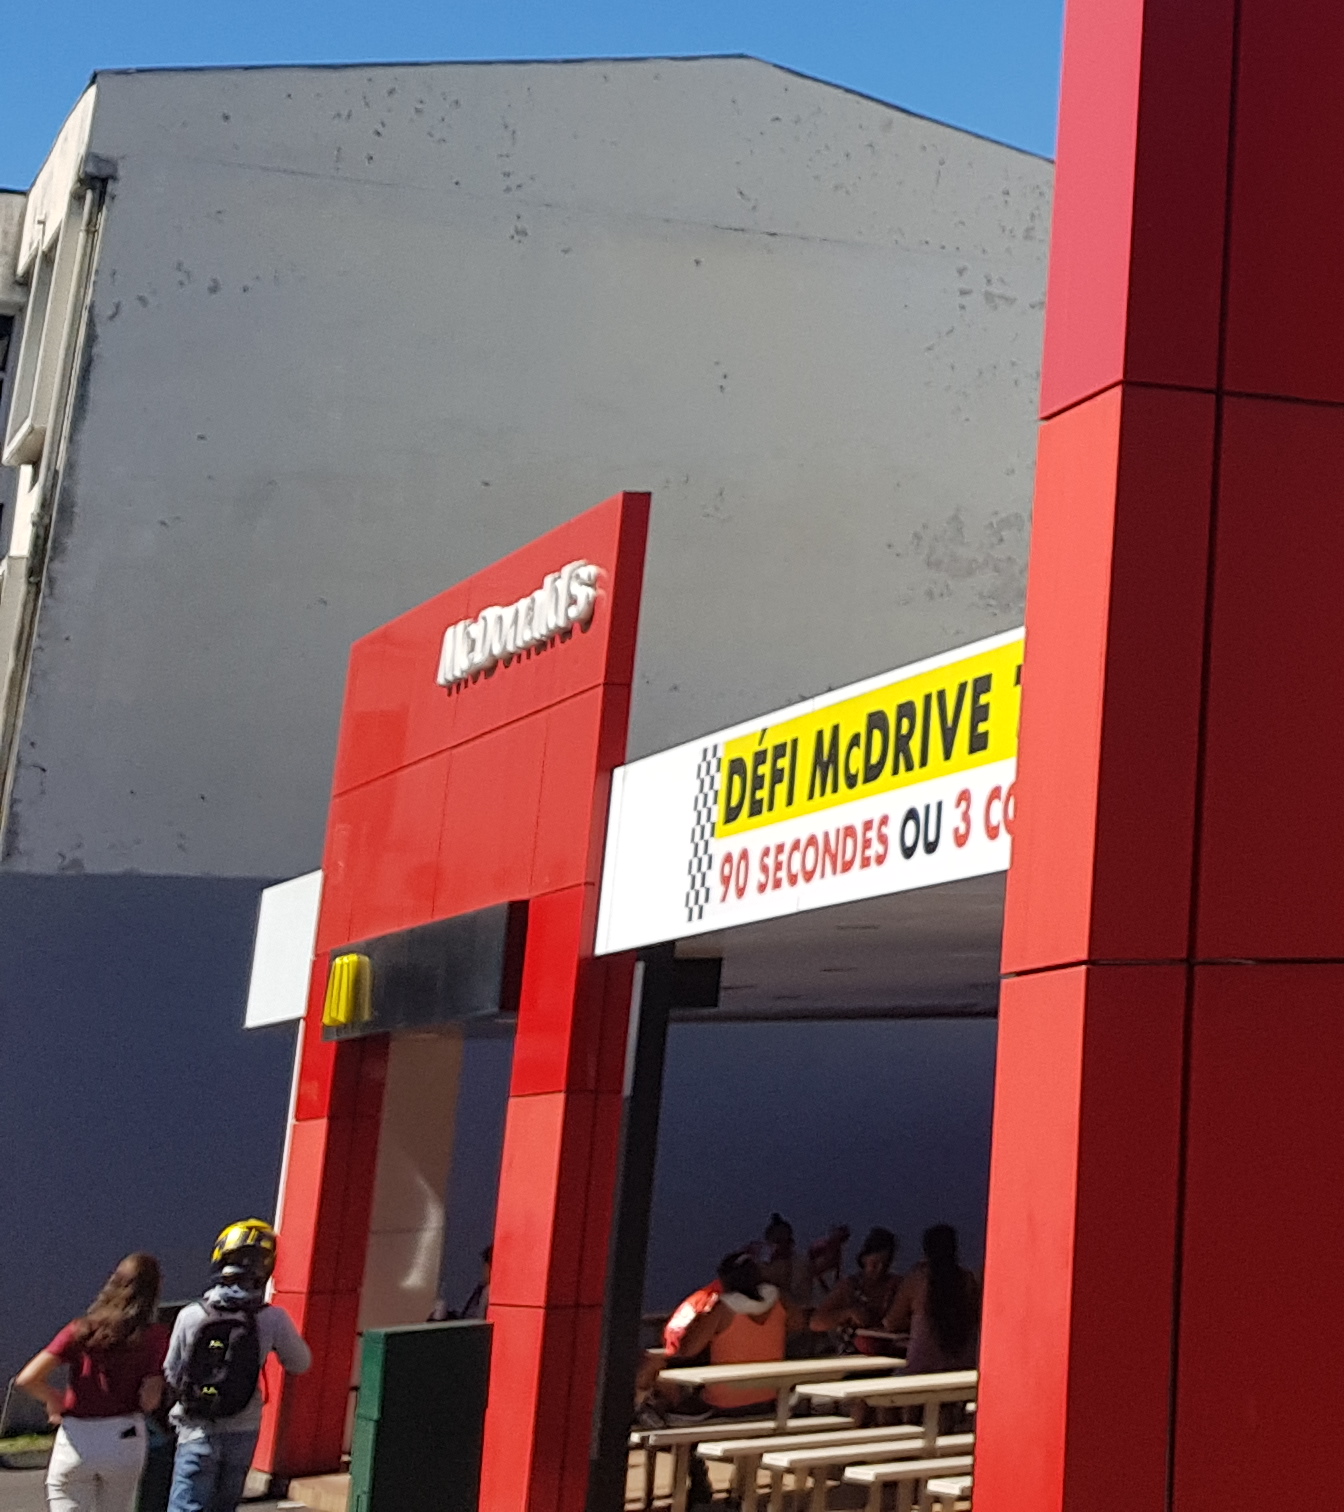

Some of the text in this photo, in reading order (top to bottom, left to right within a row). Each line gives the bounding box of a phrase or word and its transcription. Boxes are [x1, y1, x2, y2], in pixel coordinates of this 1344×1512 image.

[722, 673, 992, 825] DÉFI McDRIVE
[719, 848, 749, 903] 90
[756, 814, 889, 894] SECONDES
[899, 800, 943, 860] OU
[953, 788, 971, 849] 3
